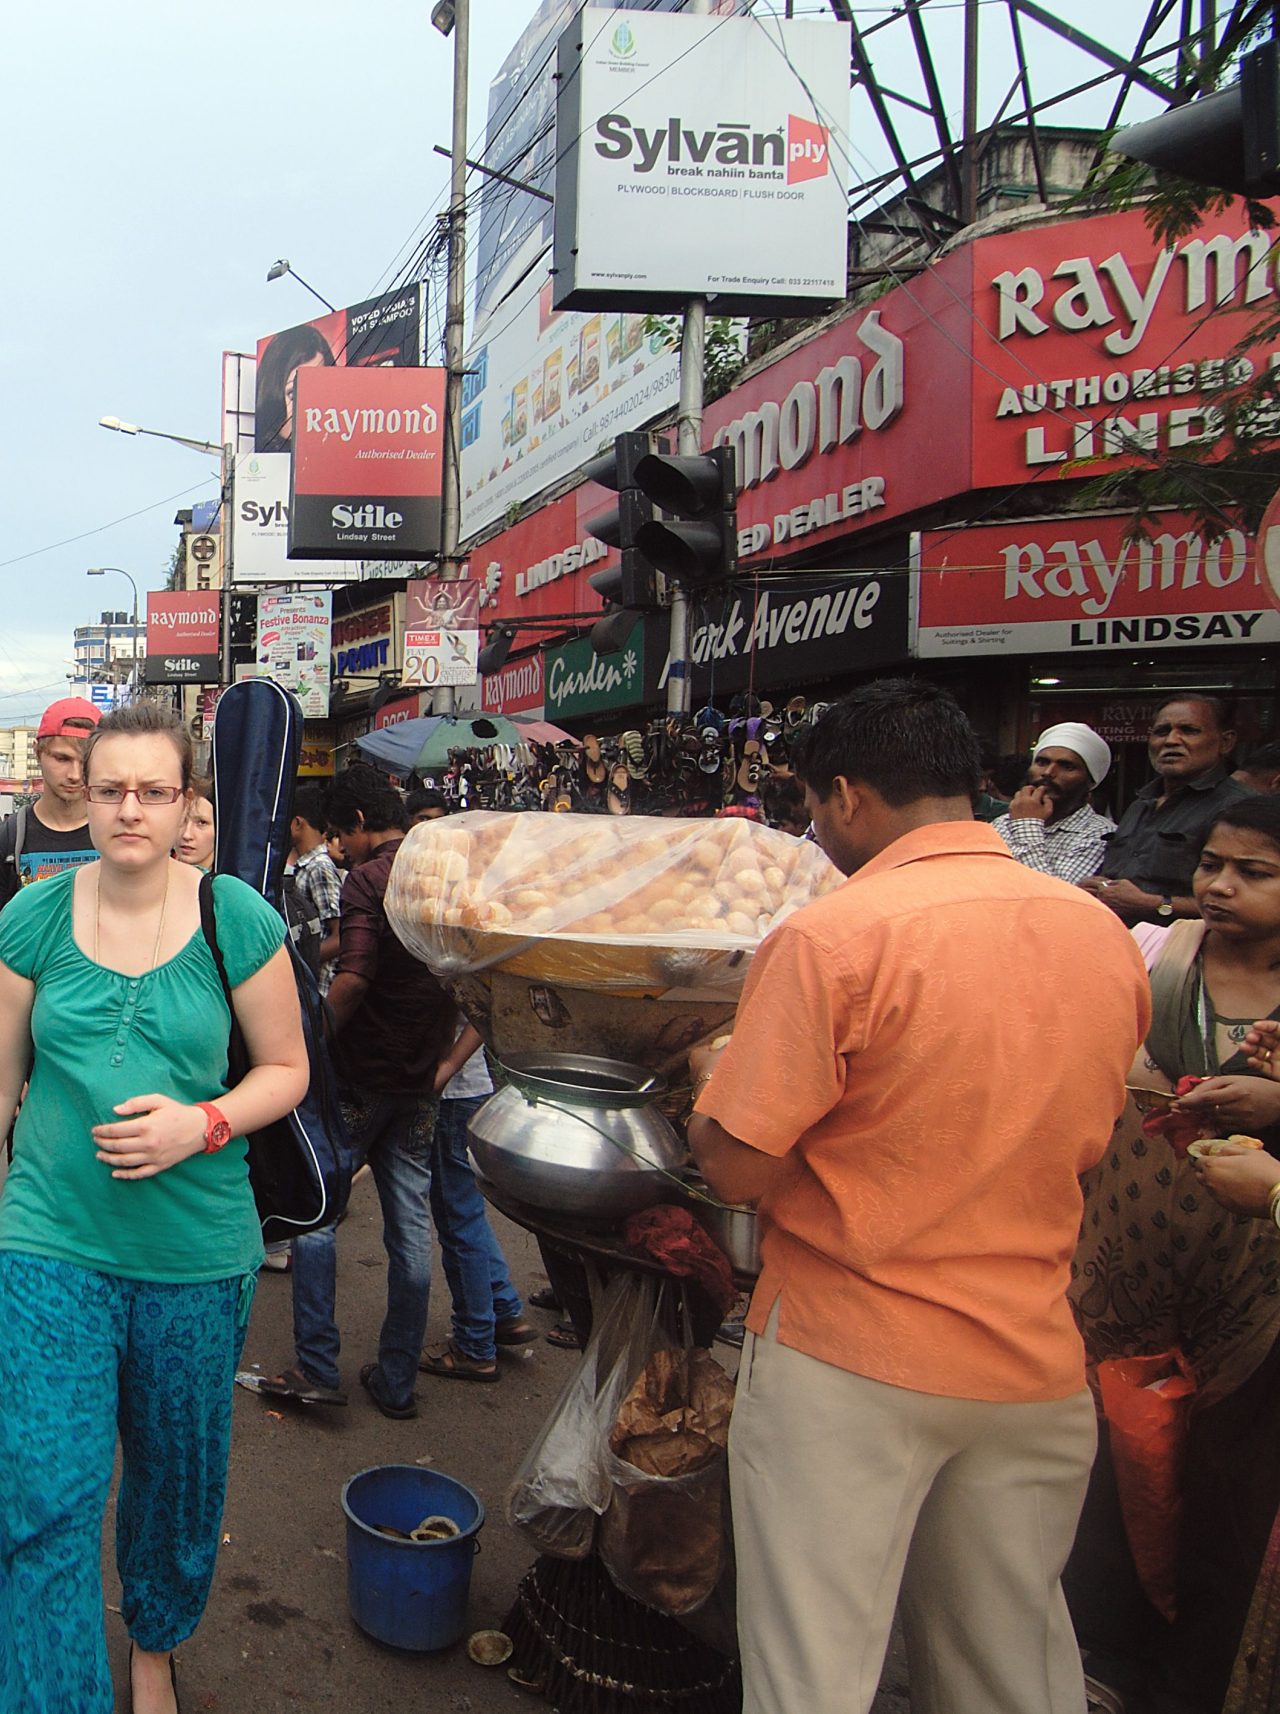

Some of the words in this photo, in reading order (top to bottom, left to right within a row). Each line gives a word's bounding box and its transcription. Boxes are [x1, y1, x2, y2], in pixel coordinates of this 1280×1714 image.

[789, 139, 827, 164] ply
[667, 165, 704, 178] break
[707, 166, 745, 179] nahiin
[748, 168, 784, 180] banta
[617, 184, 666, 196] PLYWOOD
[671, 186, 738, 198] BLOCKBOARD
[743, 189, 774, 200] FLUSH
[776, 191, 805, 201] DOOR
[590, 271, 647, 280] www.sylvanply.com
[707, 275, 719, 284] For
[721, 276, 740, 284] Trade
[742, 277, 769, 287] Enquiry
[771, 277, 787, 286] Call:
[991, 228, 1280, 357] Raym
[713, 310, 903, 492] mond
[305, 403, 437, 442] Raymond
[355, 449, 404, 460] Authorised
[406, 450, 436, 460] Dealer
[331, 504, 403, 529] Stile
[773, 477, 886, 544] DEALER
[337, 533, 368, 543] Lindsay
[371, 533, 397, 541] Street
[998, 527, 1262, 616] Raymo
[151, 608, 217, 629] Raymond
[260, 615, 290, 630] Festive
[292, 614, 329, 625] Bonanza
[742, 580, 881, 655] Avenue
[1070, 613, 1264, 647] LINDSAY
[409, 635, 437, 643] TIMEX
[164, 659, 200, 672] Stile
[338, 639, 390, 677] PRINT
[405, 655, 440, 684] 20
[485, 654, 542, 713] Raymond
[549, 656, 623, 707] Garden
